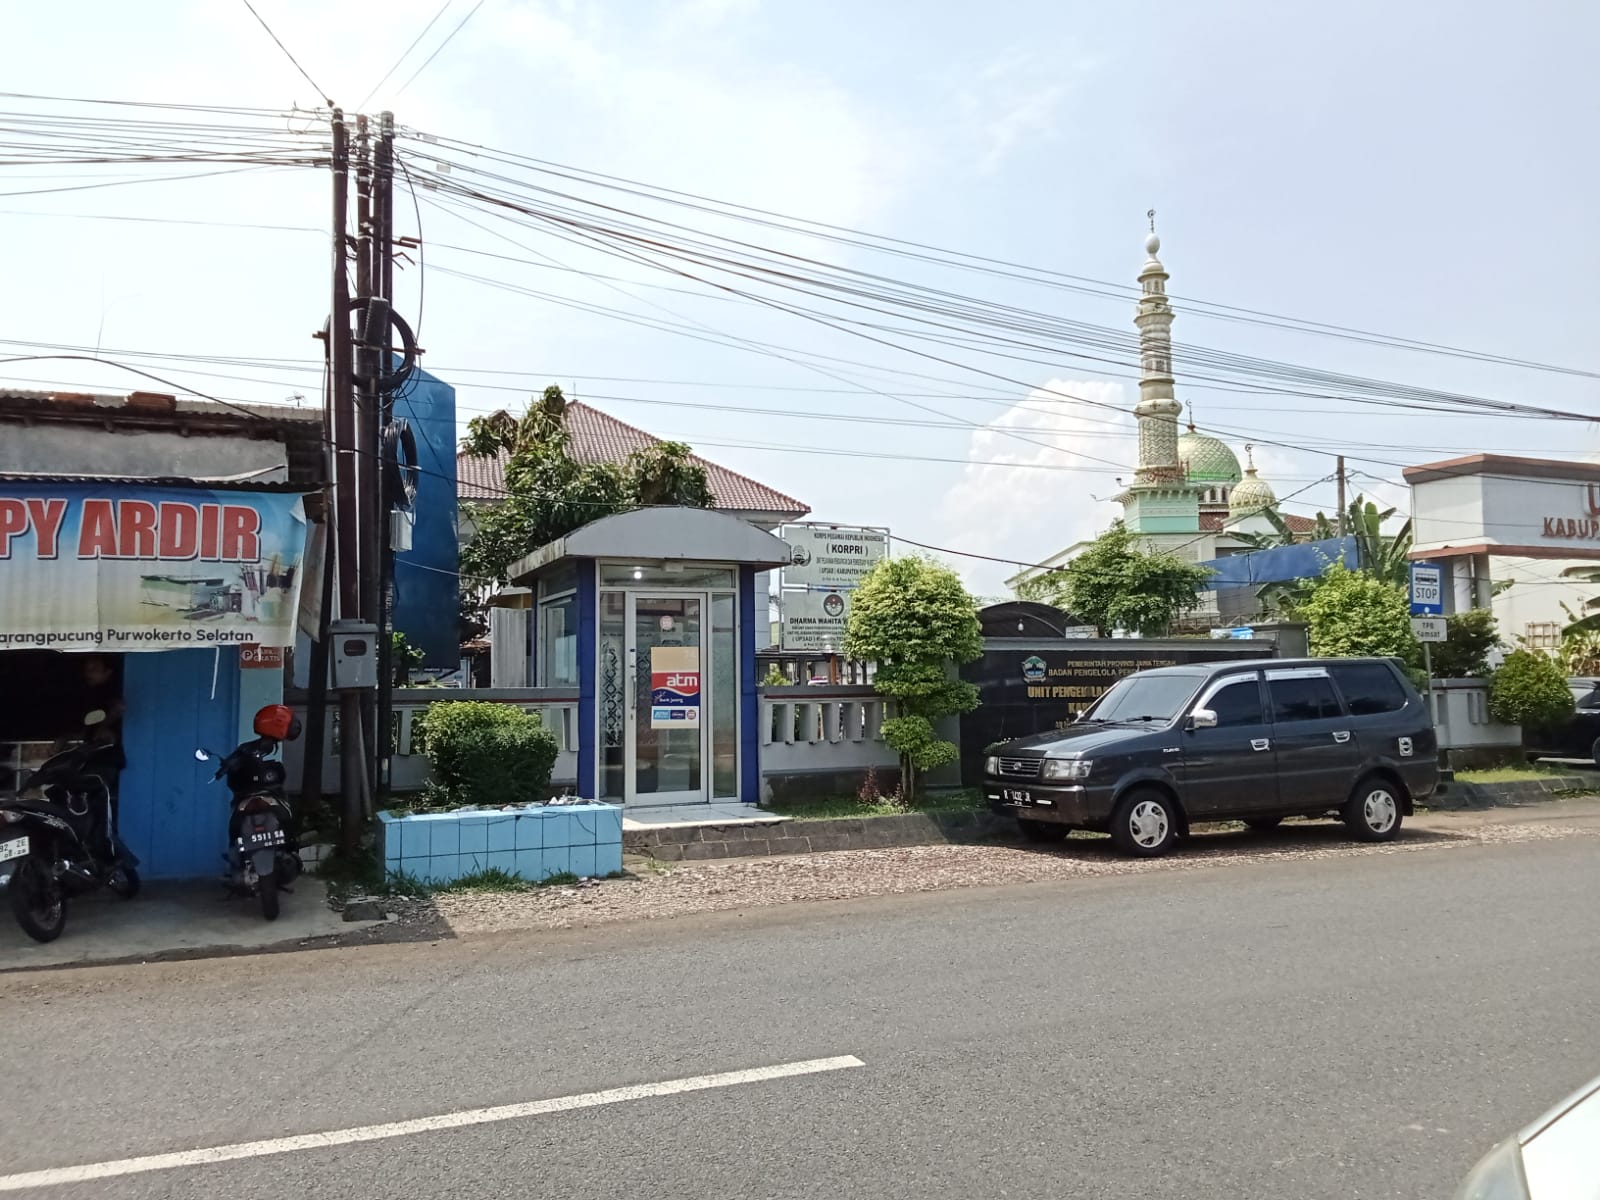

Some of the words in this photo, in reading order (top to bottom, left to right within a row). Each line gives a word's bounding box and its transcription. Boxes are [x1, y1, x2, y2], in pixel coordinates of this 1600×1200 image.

[78, 498, 261, 562] ARDIR
[1415, 588, 1438, 599] STOP
[107, 628, 192, 641] Purwokerto
[196, 629, 254, 641] Selatan
[1048, 668, 1073, 676] BADAN
[666, 673, 698, 687] atm
[1027, 686, 1050, 698] UNIT
